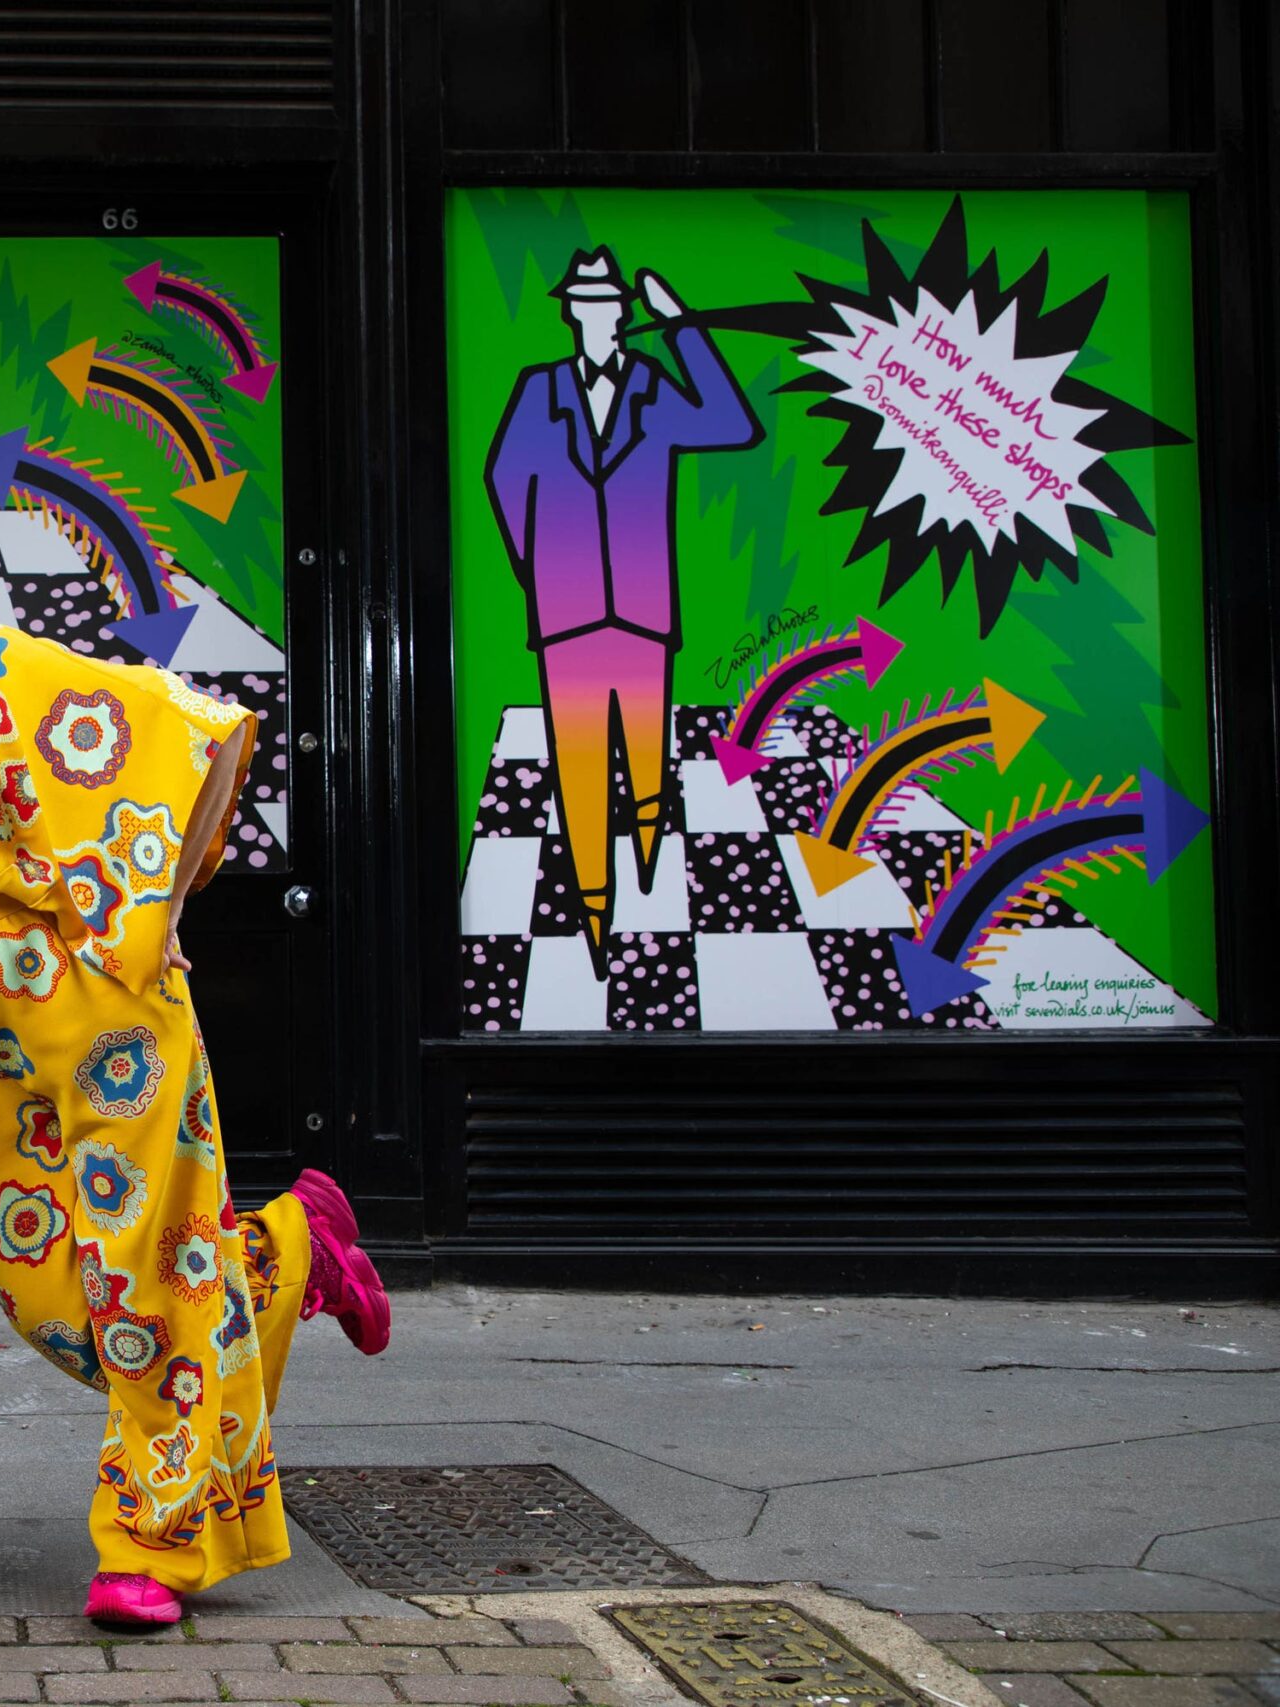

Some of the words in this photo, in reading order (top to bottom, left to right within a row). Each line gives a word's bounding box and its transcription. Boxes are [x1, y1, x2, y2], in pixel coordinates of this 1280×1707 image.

[102, 207, 139, 230] 66
[912, 314, 973, 373] How
[975, 370, 1059, 441] much
[846, 324, 879, 362] I
[877, 345, 931, 400] love
[934, 387, 1001, 450] these
[1004, 441, 1073, 502] shops
[1013, 973, 1038, 1000] for
[1039, 971, 1089, 999] leasing
[994, 1002, 1020, 1017] visit
